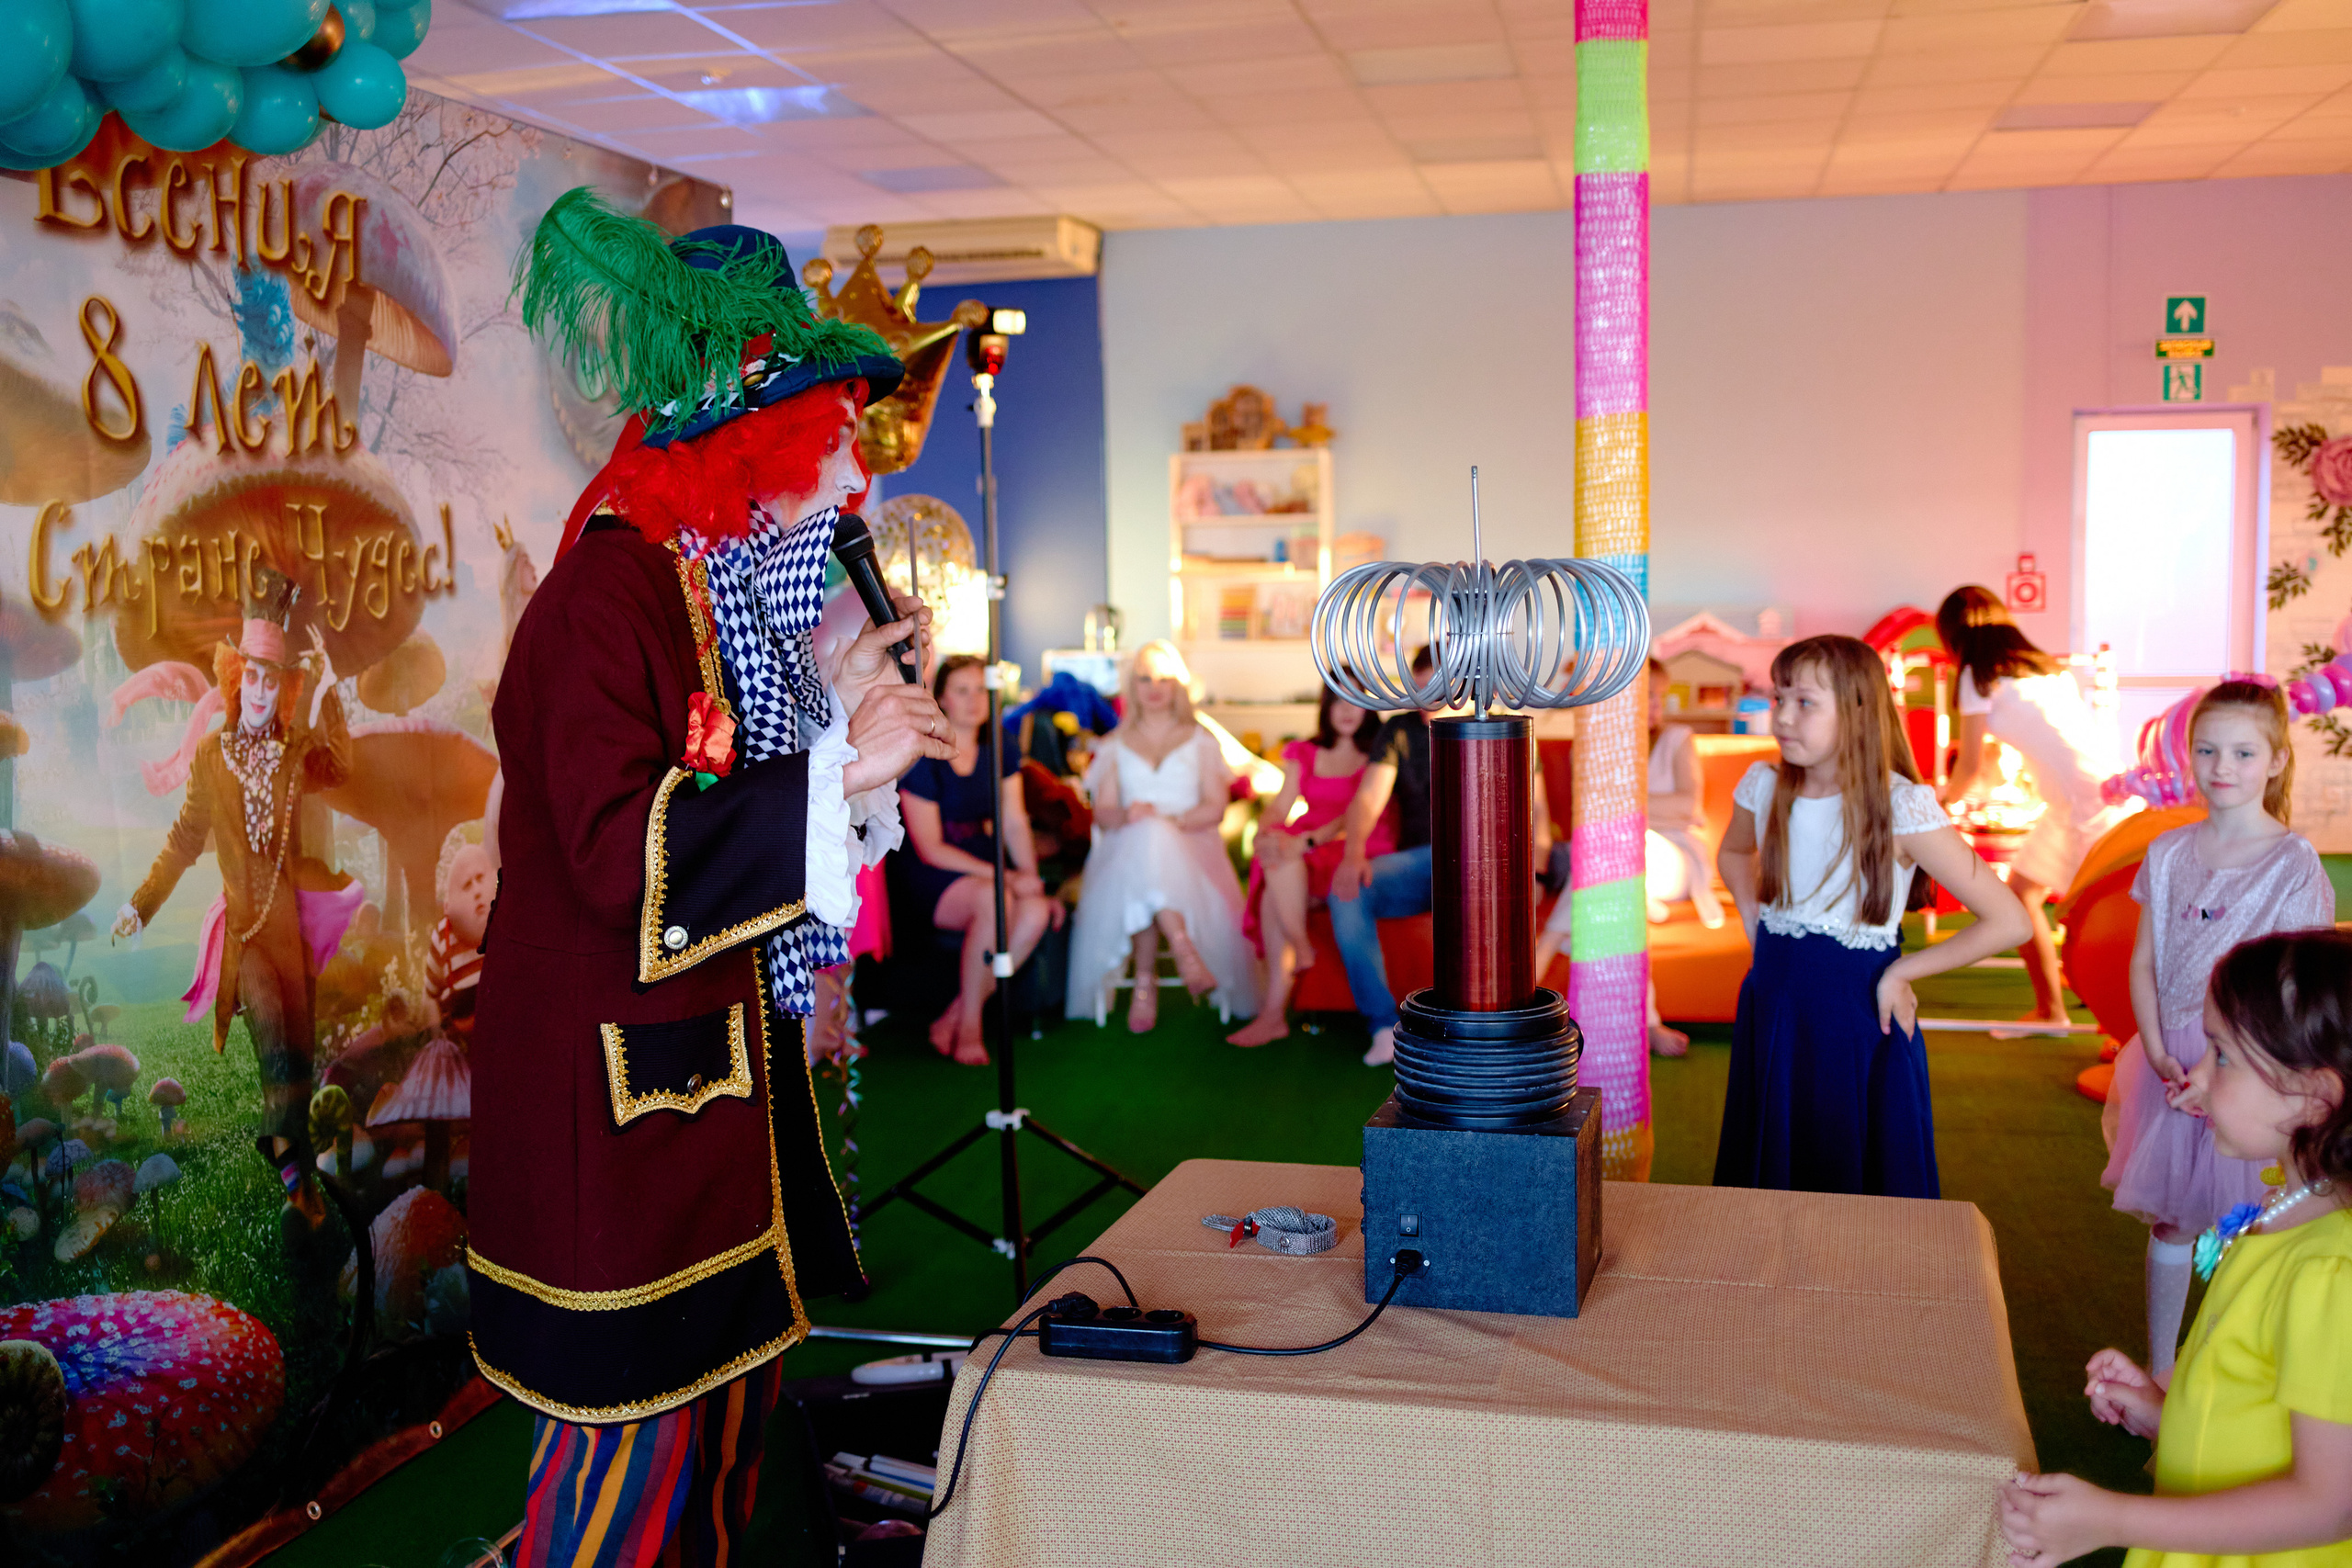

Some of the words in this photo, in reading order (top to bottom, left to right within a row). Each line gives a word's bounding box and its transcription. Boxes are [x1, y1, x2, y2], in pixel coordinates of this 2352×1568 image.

[79, 295, 138, 441] 8
[28, 498, 269, 640] Стране
[286, 502, 455, 632] Чудес!
